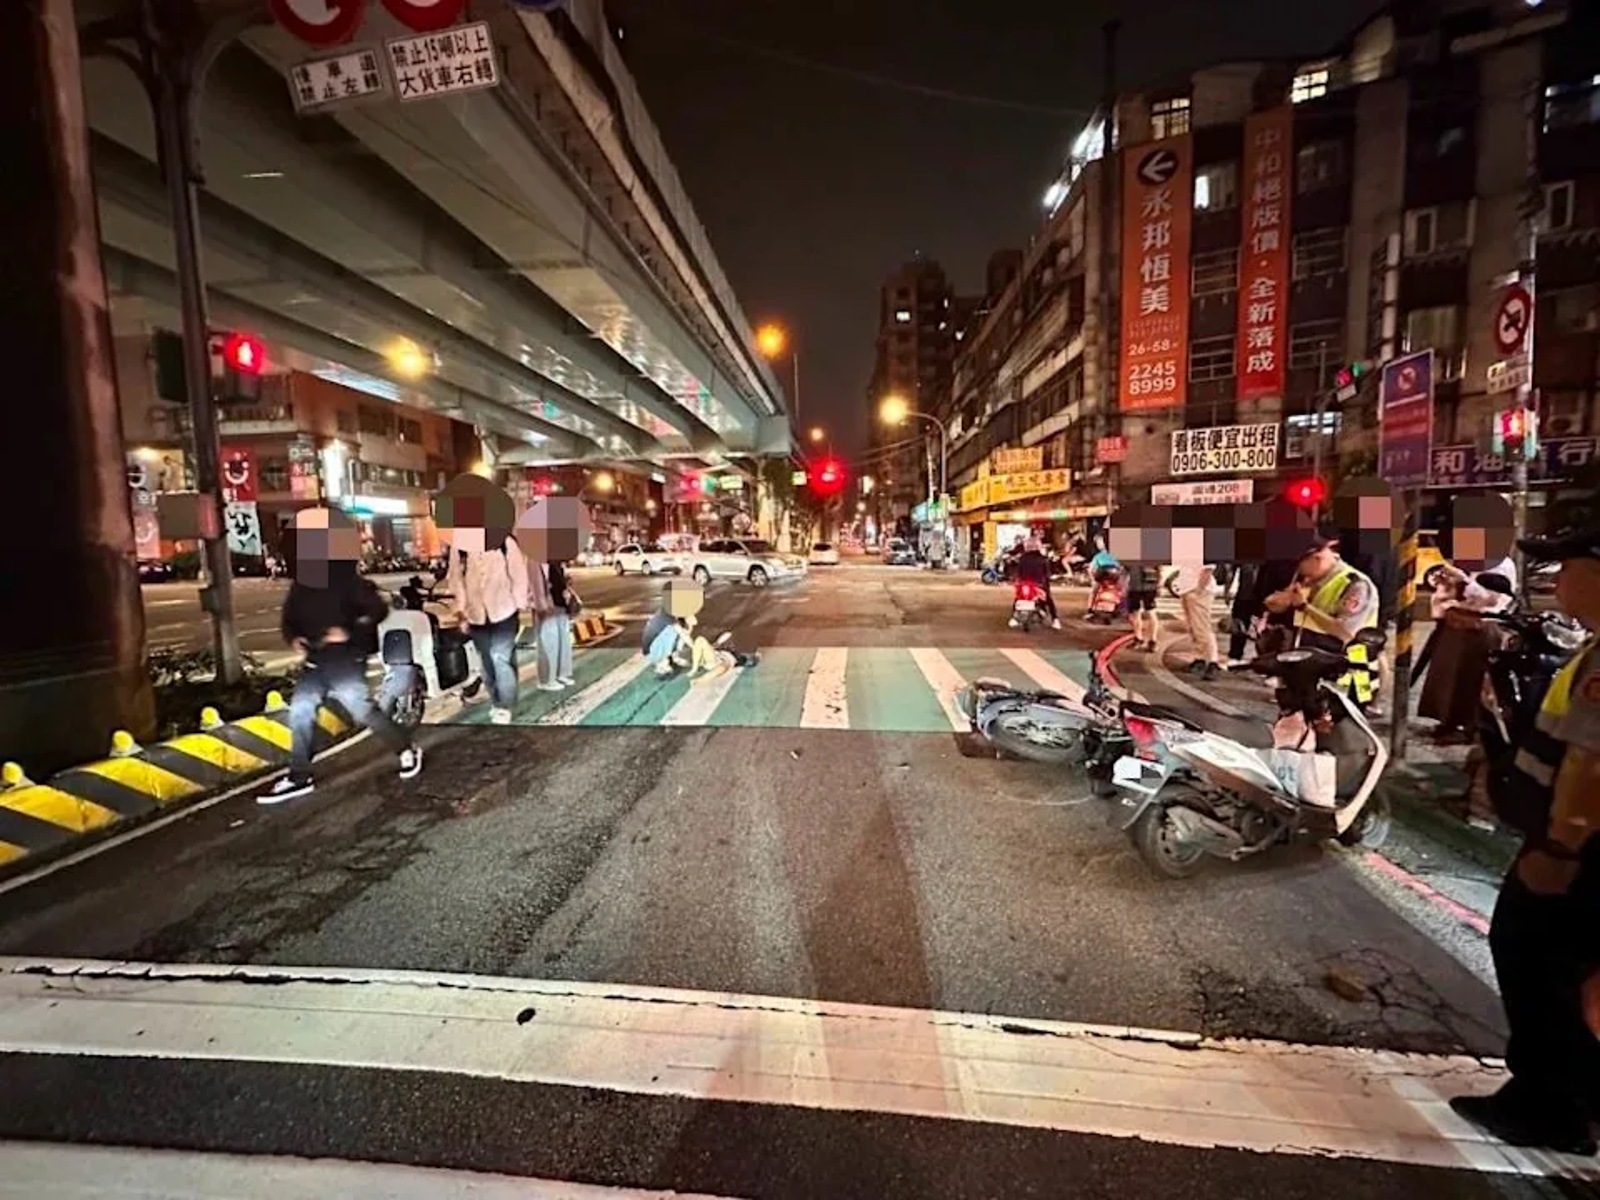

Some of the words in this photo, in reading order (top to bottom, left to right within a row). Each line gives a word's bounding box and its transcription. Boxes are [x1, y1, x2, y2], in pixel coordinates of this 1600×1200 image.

[400, 58, 494, 95] 大貨車右轉
[1141, 188, 1172, 316] 永邦恆美
[1129, 360, 1176, 380] 2245
[1129, 376, 1176, 395] 8999
[1174, 425, 1276, 452] 看板便宜出租
[1172, 448, 1275, 473] 0906-300-800
